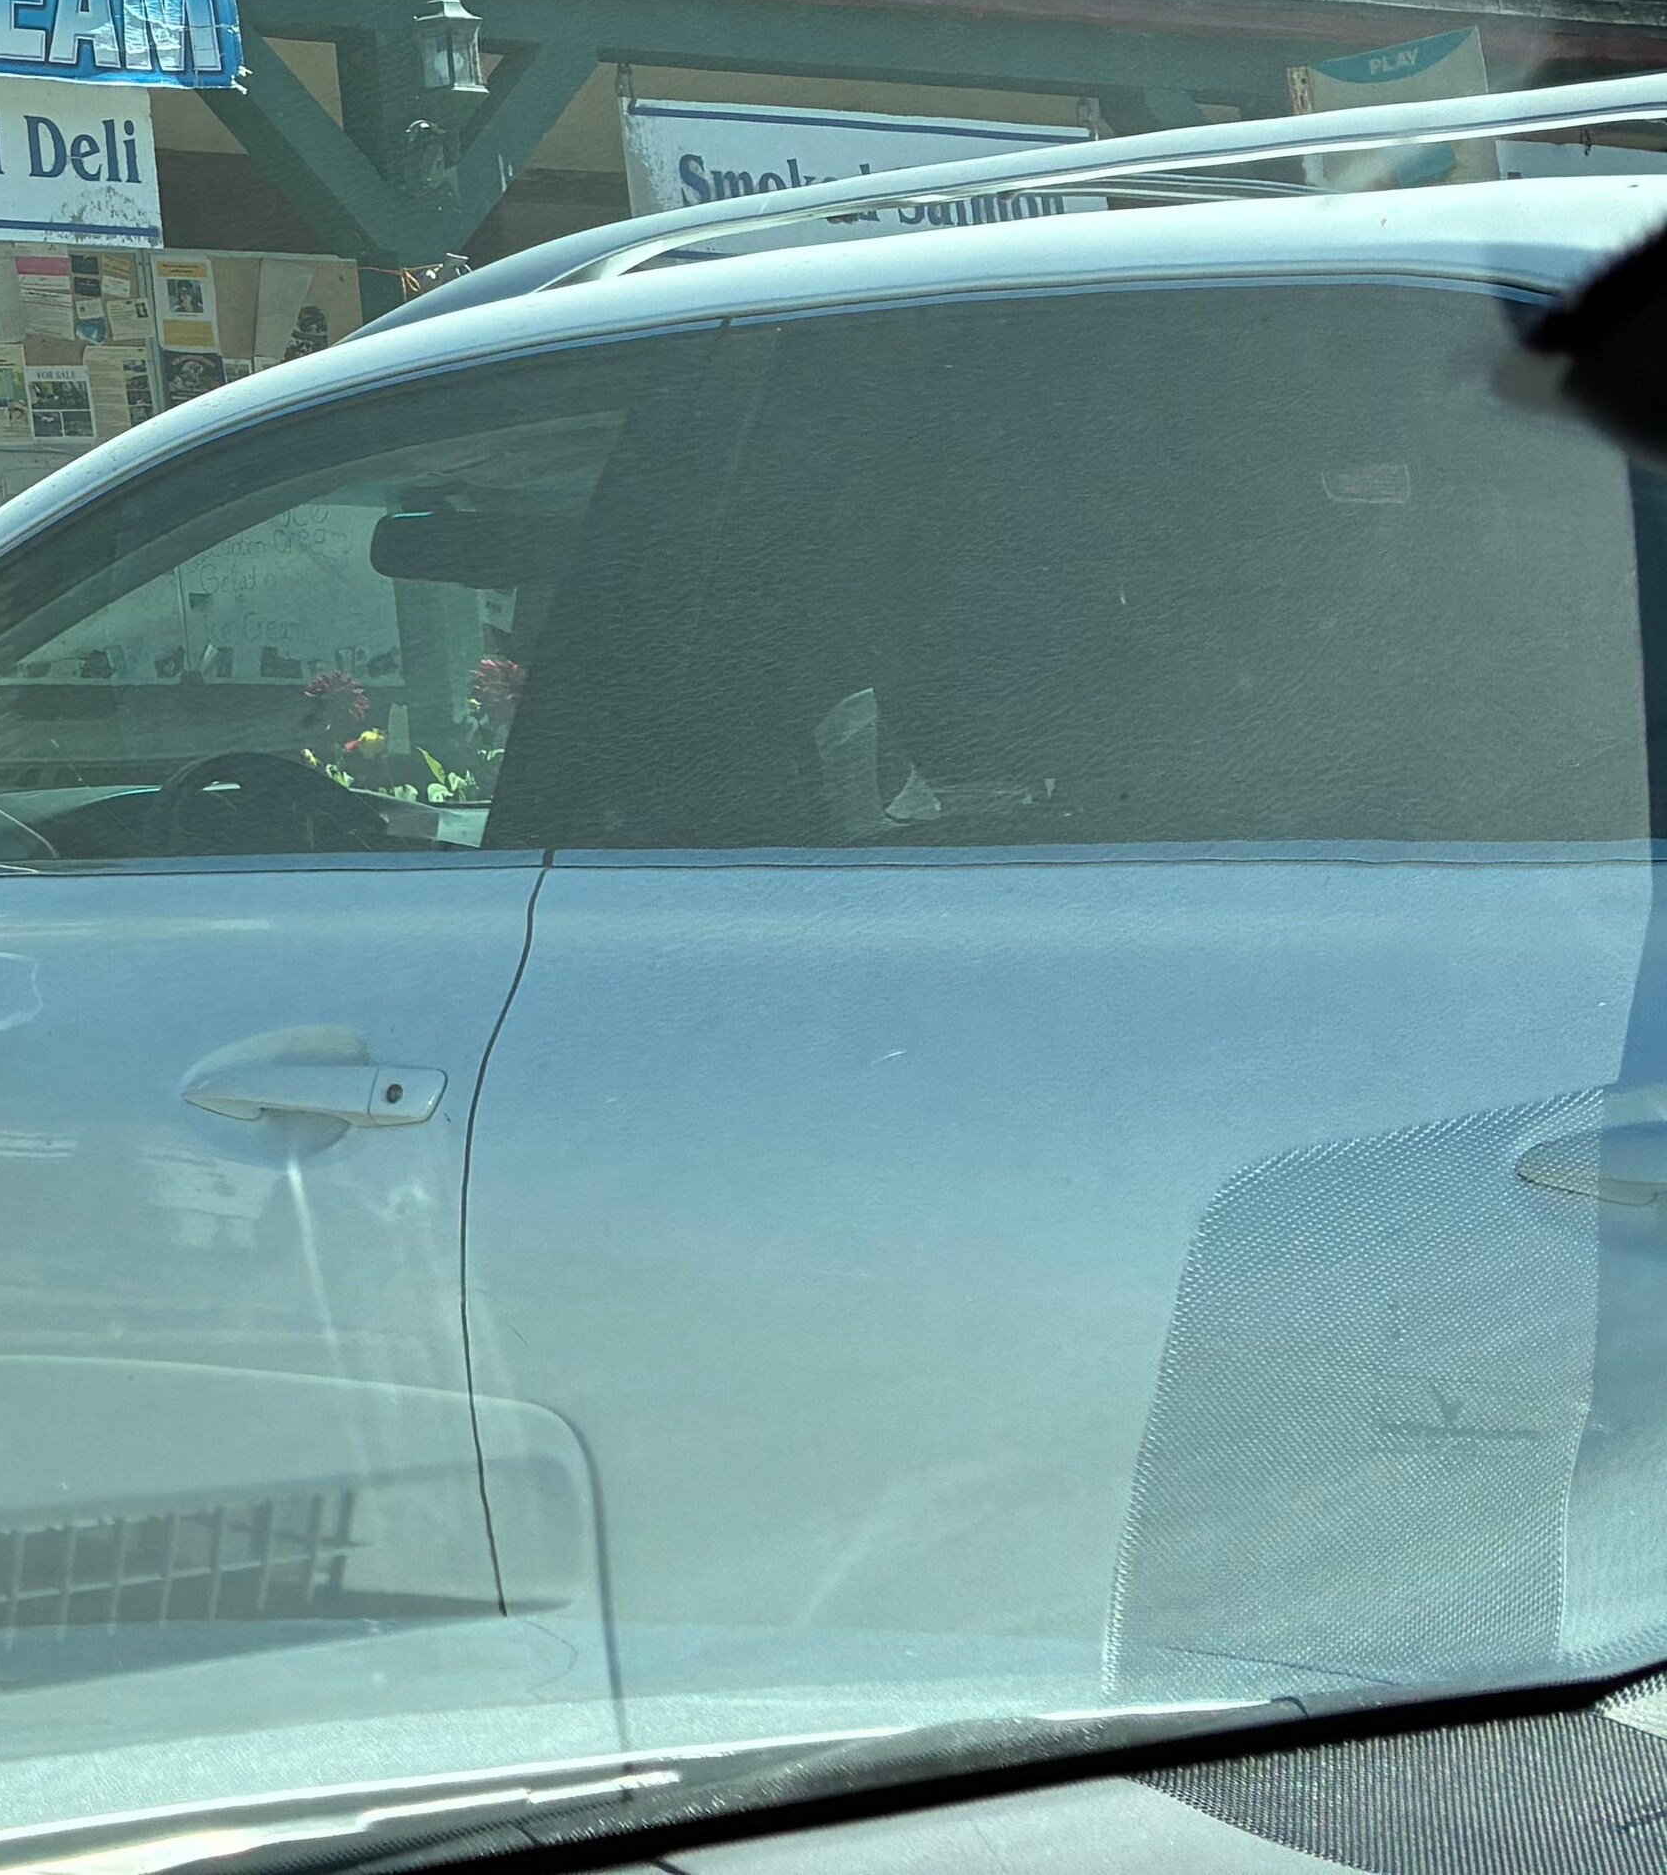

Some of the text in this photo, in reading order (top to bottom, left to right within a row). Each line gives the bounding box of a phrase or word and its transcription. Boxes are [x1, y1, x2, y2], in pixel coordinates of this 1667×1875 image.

[1368, 48, 1420, 76] PLAY
[24, 114, 143, 185] Deli
[36, 370, 76, 380] FOR SALE
